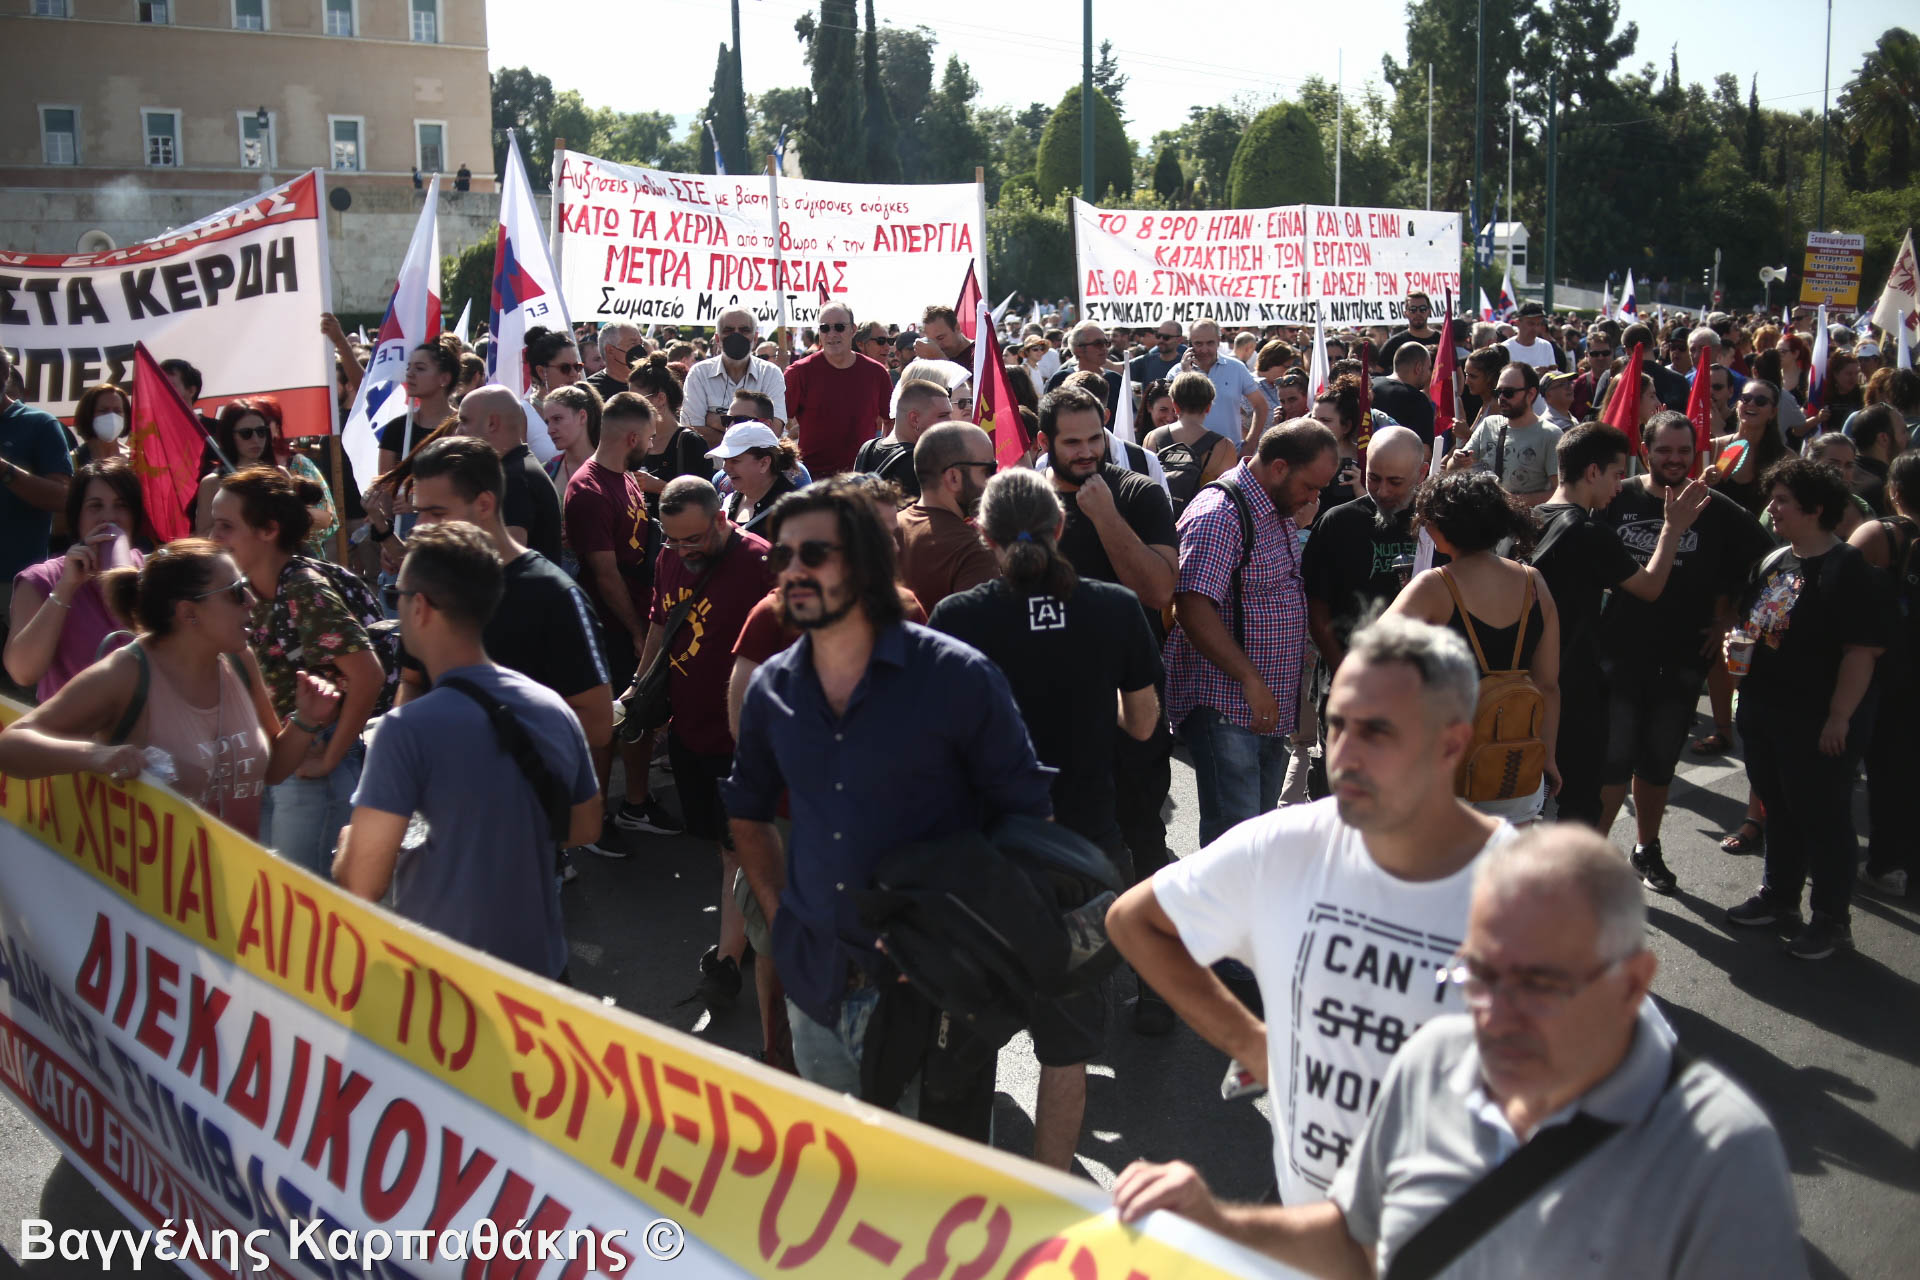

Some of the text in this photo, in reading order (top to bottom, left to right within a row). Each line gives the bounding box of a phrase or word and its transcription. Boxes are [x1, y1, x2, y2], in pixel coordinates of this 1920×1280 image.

[715, 192, 729, 213] με
[736, 184, 768, 209] βάση
[795, 192, 853, 219] σύγχρονες
[860, 196, 909, 220] ανάγκες
[629, 208, 657, 241] ΤΑ
[664, 210, 728, 247] ΧΕΡΙΑ
[737, 230, 758, 247] από
[763, 236, 775, 248] το
[843, 239, 865, 256] την
[872, 222, 973, 253] ΑΠΕΡΓΙΑ
[1098, 213, 1127, 235] ΤΟ
[1207, 214, 1255, 241] ΗΤΑΝ
[1317, 211, 1339, 237] ΚΑΙ
[1345, 211, 1363, 238] ΘΑ
[1368, 213, 1400, 239] ΕΙΝΑΙ
[603, 244, 848, 293] ΜΕΤΡΑ ΠΡΟΣΤΑΣΙΑΣ
[1154, 245, 1263, 271] ΚΑΤΑΚΤΗΣΗ
[1313, 241, 1372, 267] ΕΡΓΑΤΩΝ
[119, 235, 299, 321] ΚΕΡΔΗ
[1086, 269, 1109, 297] ΔΕ
[1113, 269, 1138, 297] ΘΑ
[1150, 269, 1281, 300] ΣΤΑΜΑΤΗΣΕΤΕ
[1291, 272, 1311, 297] ΤΗ
[1322, 271, 1366, 297] ΔΡΑΣΗ
[1374, 271, 1398, 296] ΤΩΝ
[597, 287, 684, 321] Σωματείο
[1173, 301, 1250, 323] ΜΕΤΑΛΛΟΥ
[1622, 513, 1638, 521] NYC
[71, 771, 218, 942] ΧΕΡΙΑ
[236, 869, 367, 1014] ΑΠΟ
[380, 939, 478, 1073] ΤΟ
[1323, 933, 1450, 1005] CAN'T
[1313, 996, 1420, 1056] STO
